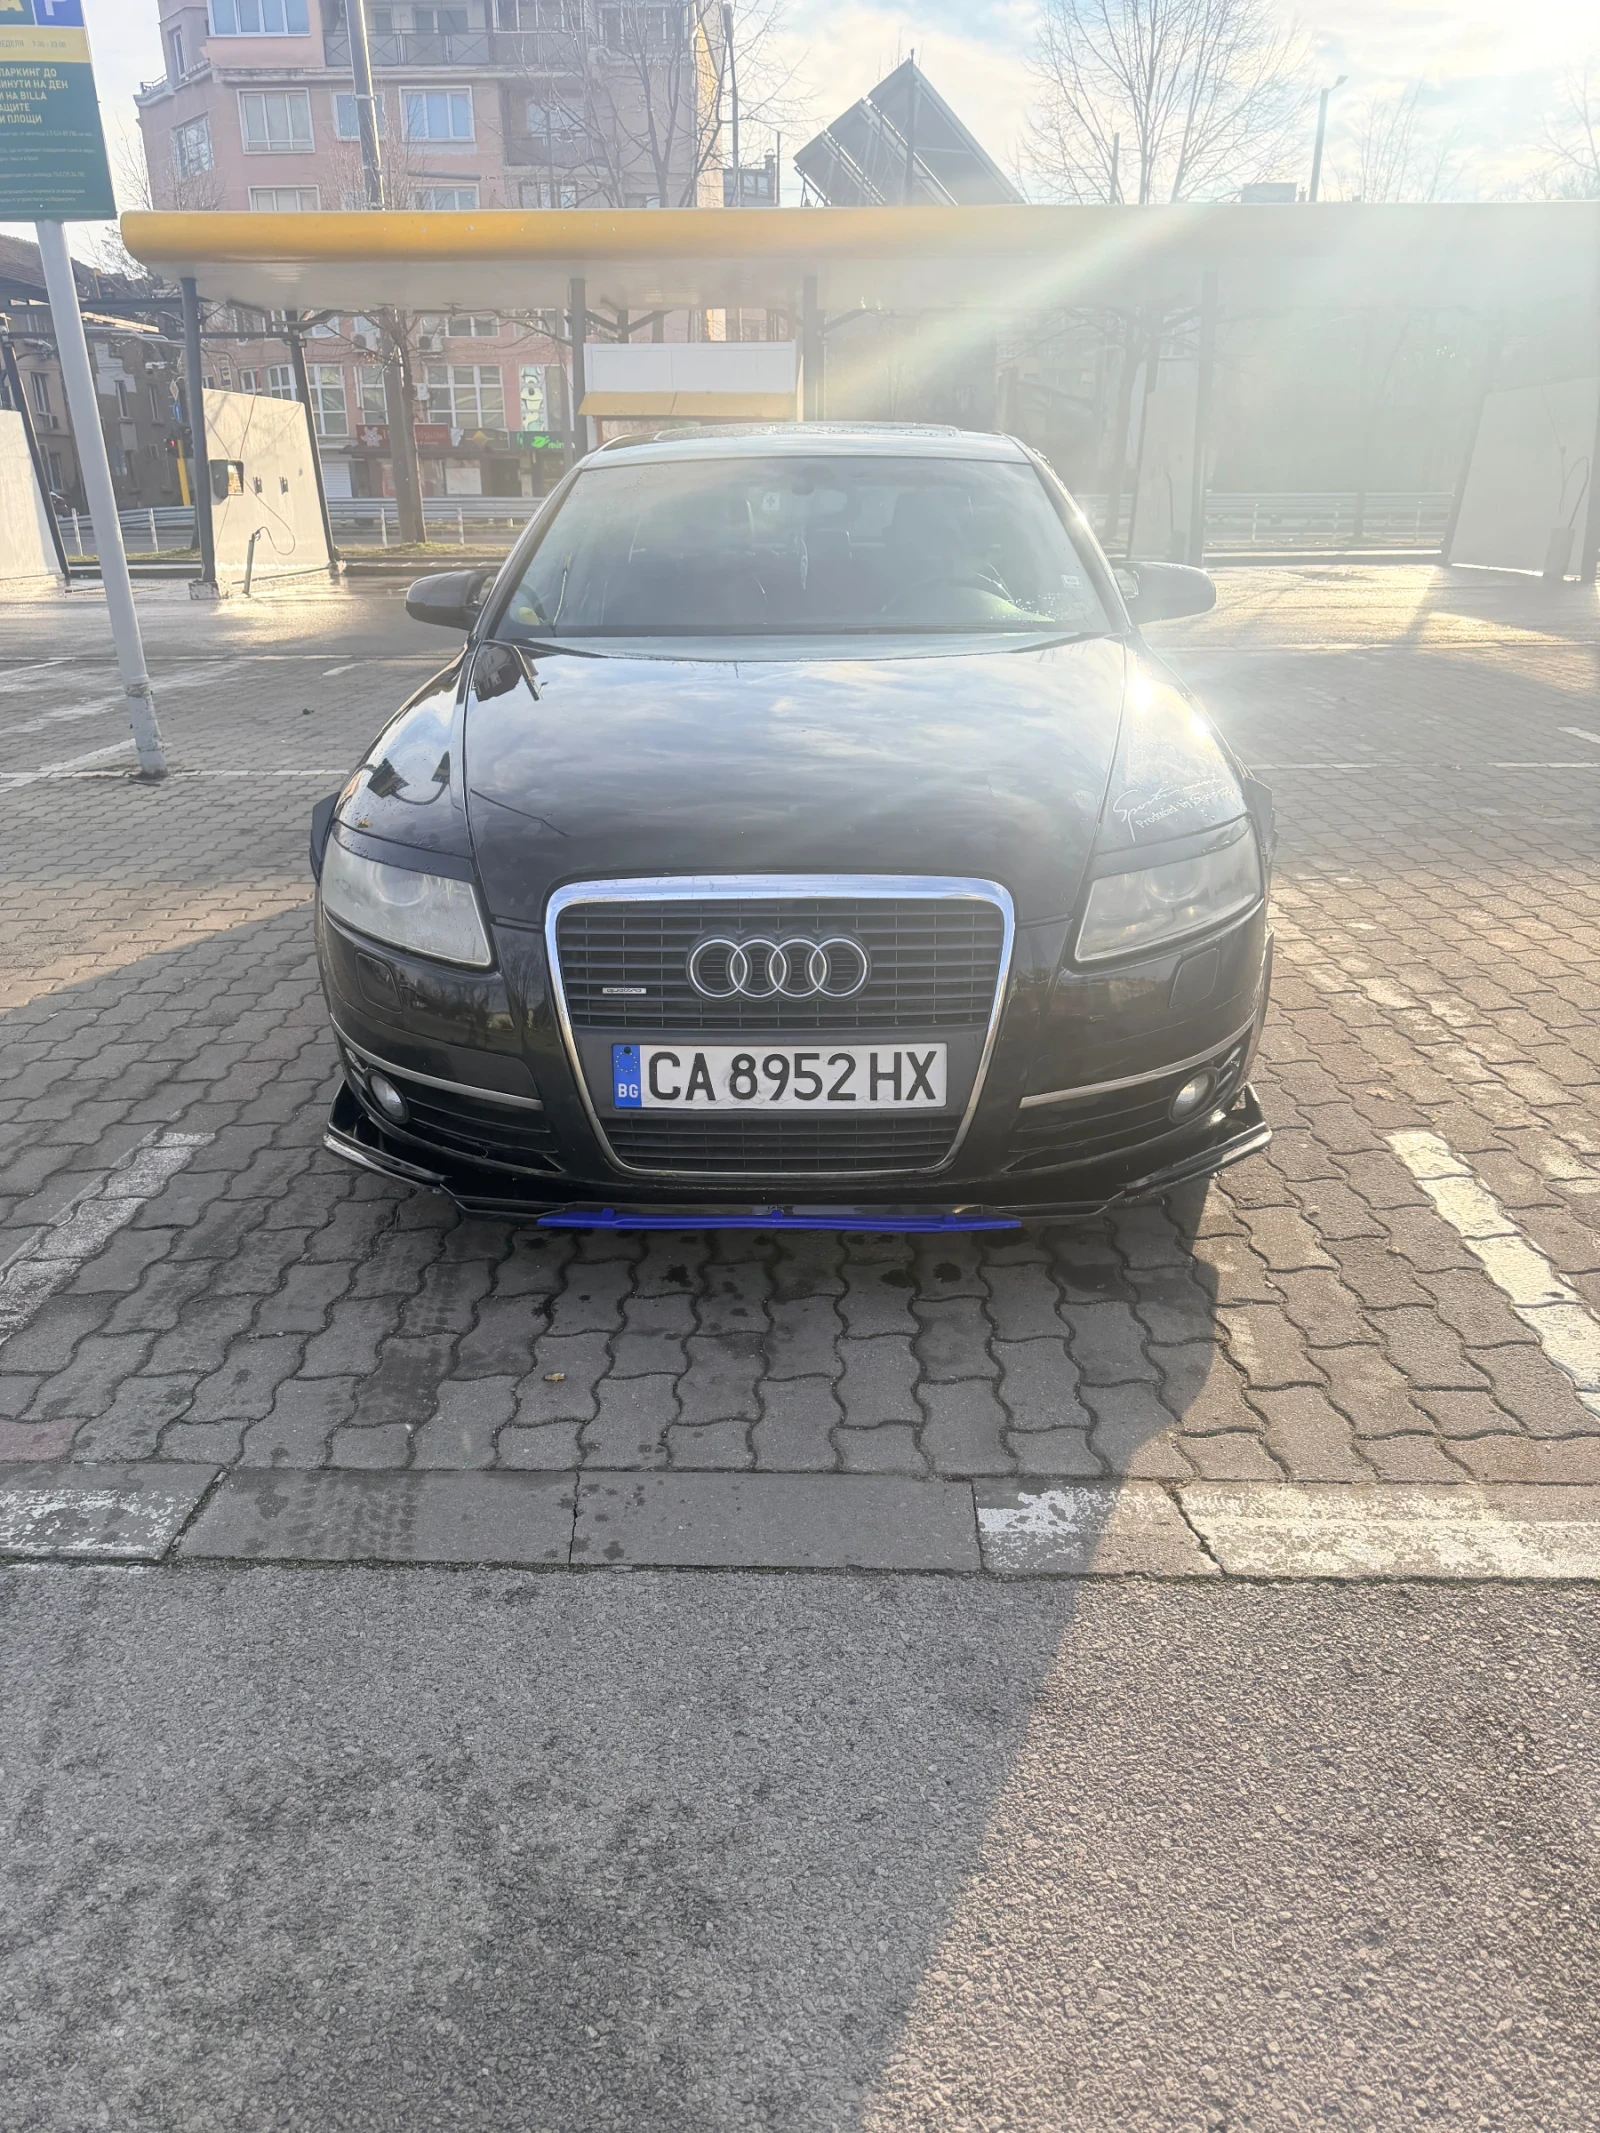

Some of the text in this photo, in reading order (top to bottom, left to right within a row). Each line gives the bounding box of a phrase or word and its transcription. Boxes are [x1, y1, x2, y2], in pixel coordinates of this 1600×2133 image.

[0, 40, 24, 48] ЕДЕЛЯ
[44, 68, 57, 79] ДО
[0, 80, 69, 90] ИНУТИ НА ДЕН
[5, 92, 19, 100] НА
[20, 92, 47, 100] BILLA
[7, 114, 43, 125] ПЛОЩИ
[1135, 804, 1179, 828] Produced
[649, 1051, 938, 1101] CA 8952 HX
[617, 1083, 639, 1099] BG
